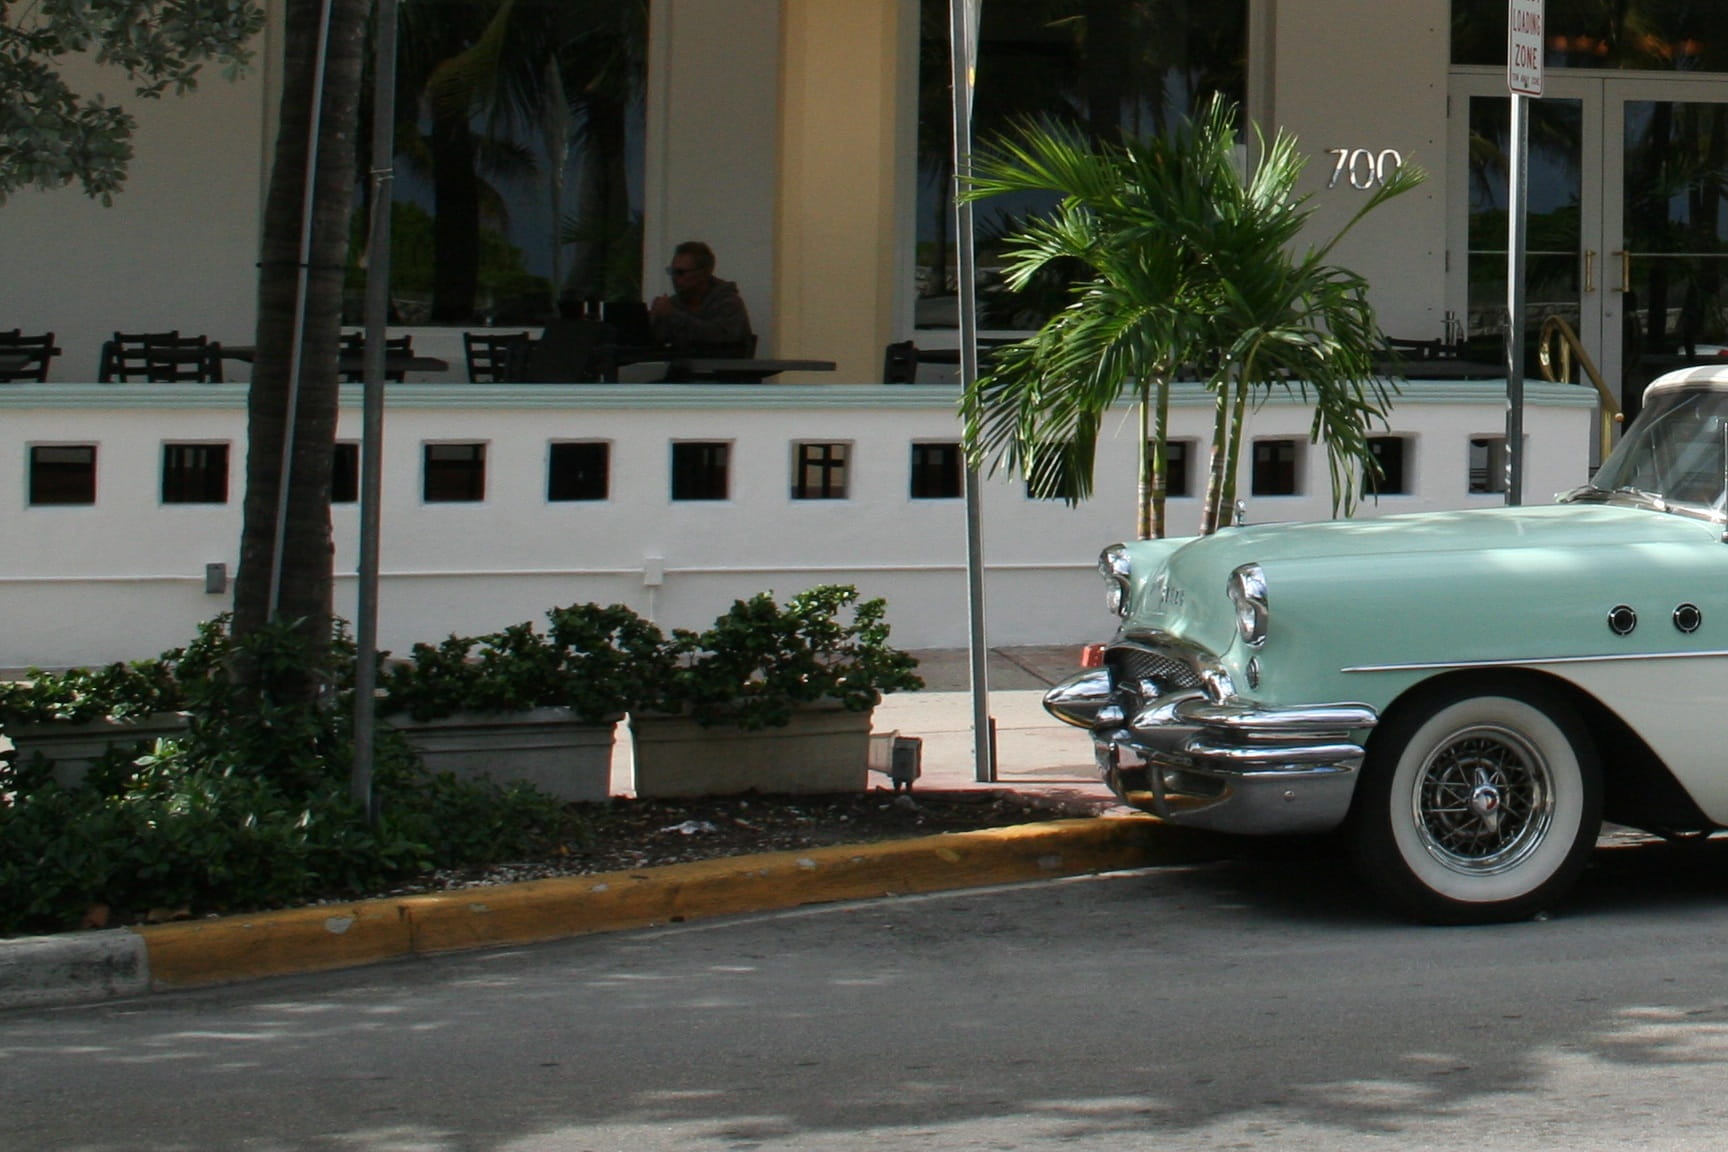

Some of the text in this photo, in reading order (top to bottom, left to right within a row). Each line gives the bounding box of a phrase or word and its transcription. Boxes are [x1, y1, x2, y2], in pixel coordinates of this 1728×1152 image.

[1512, 9, 1541, 36] LOADING
[1515, 44, 1538, 70] ZONE
[1324, 148, 1402, 189] 700
